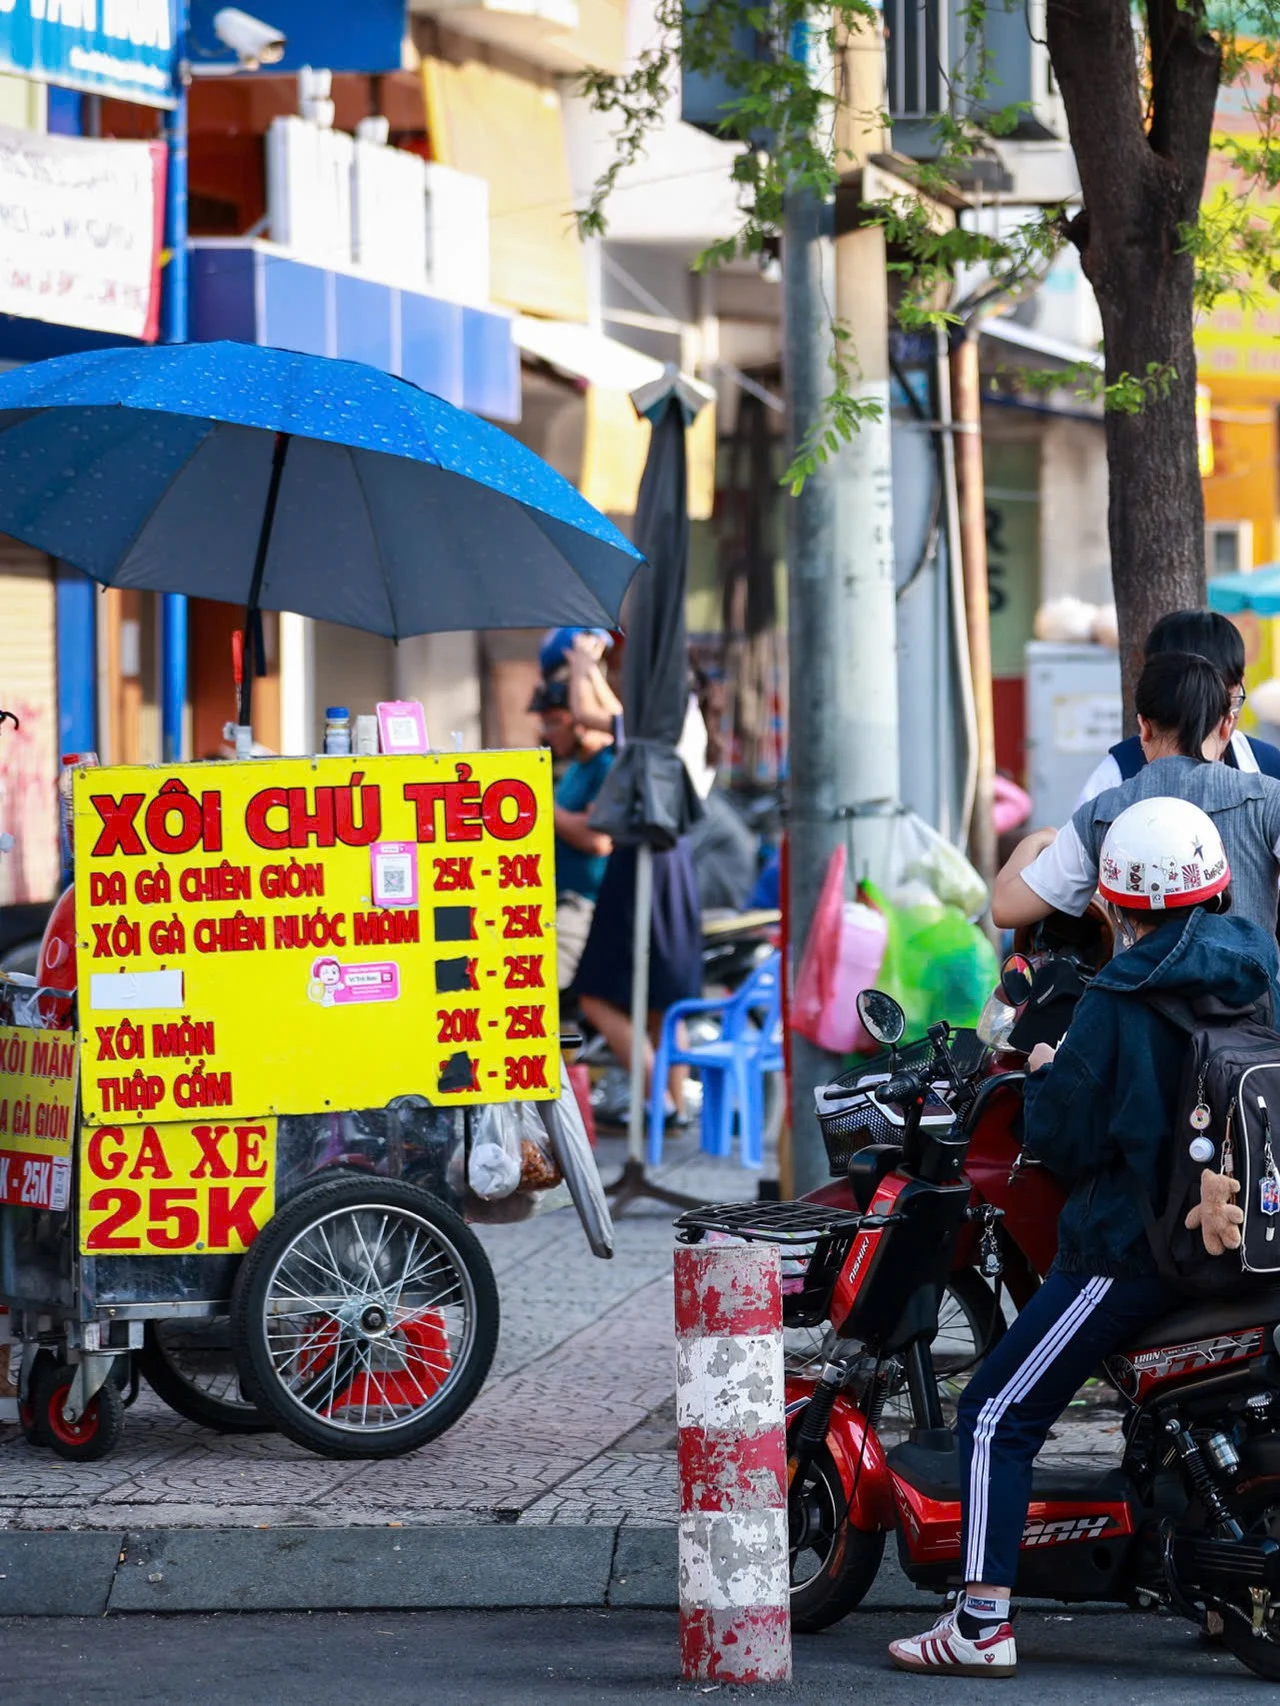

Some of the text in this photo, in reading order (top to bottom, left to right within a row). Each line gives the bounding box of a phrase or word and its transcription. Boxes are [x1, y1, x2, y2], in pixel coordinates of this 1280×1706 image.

[90, 763, 537, 857] XÔI CHÚ TẺO
[90, 857, 324, 906] DA GÀ CHIÊN GIÒN
[433, 856, 475, 891] 25K
[498, 854, 542, 889] 30K
[92, 915, 141, 958] XÔI
[149, 913, 186, 955] GÀ
[194, 910, 266, 952] CHIÊN
[273, 906, 346, 949] NƯỚC
[502, 904, 544, 938] 25K
[504, 955, 545, 989] 25K
[96, 1016, 215, 1064] XÔI MẶN
[437, 1008, 482, 1043] 20K
[505, 1005, 546, 1039] 25K
[31, 1035, 75, 1087] MẶN
[505, 1055, 548, 1090] 30K
[97, 1059, 232, 1119] THẬP CẨM
[21, 1160, 50, 1205] 25K
[87, 1186, 267, 1249] 25K
